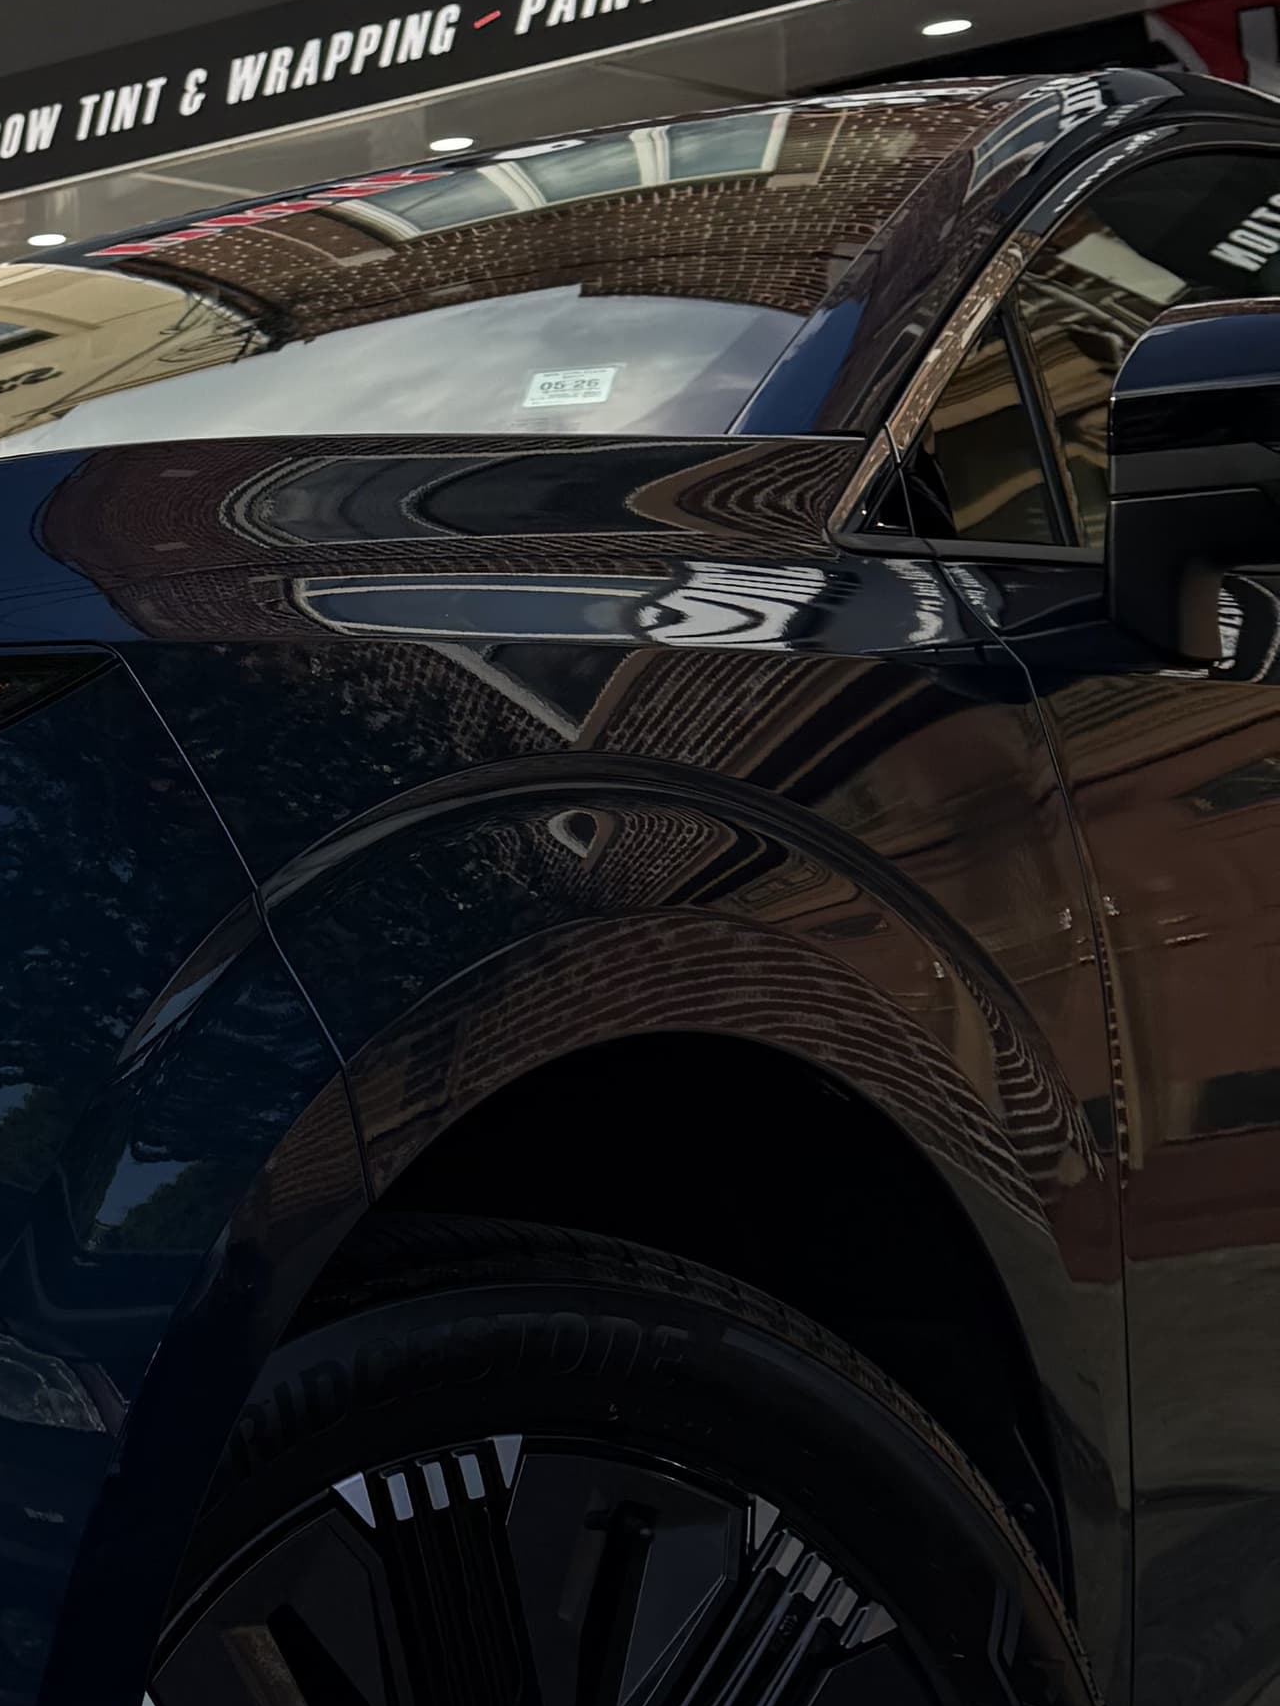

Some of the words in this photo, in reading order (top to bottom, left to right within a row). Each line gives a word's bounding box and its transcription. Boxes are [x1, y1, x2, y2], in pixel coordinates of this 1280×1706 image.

[75, 76, 168, 141] TINT
[179, 67, 208, 116] &
[226, 3, 463, 105] WRAPPING
